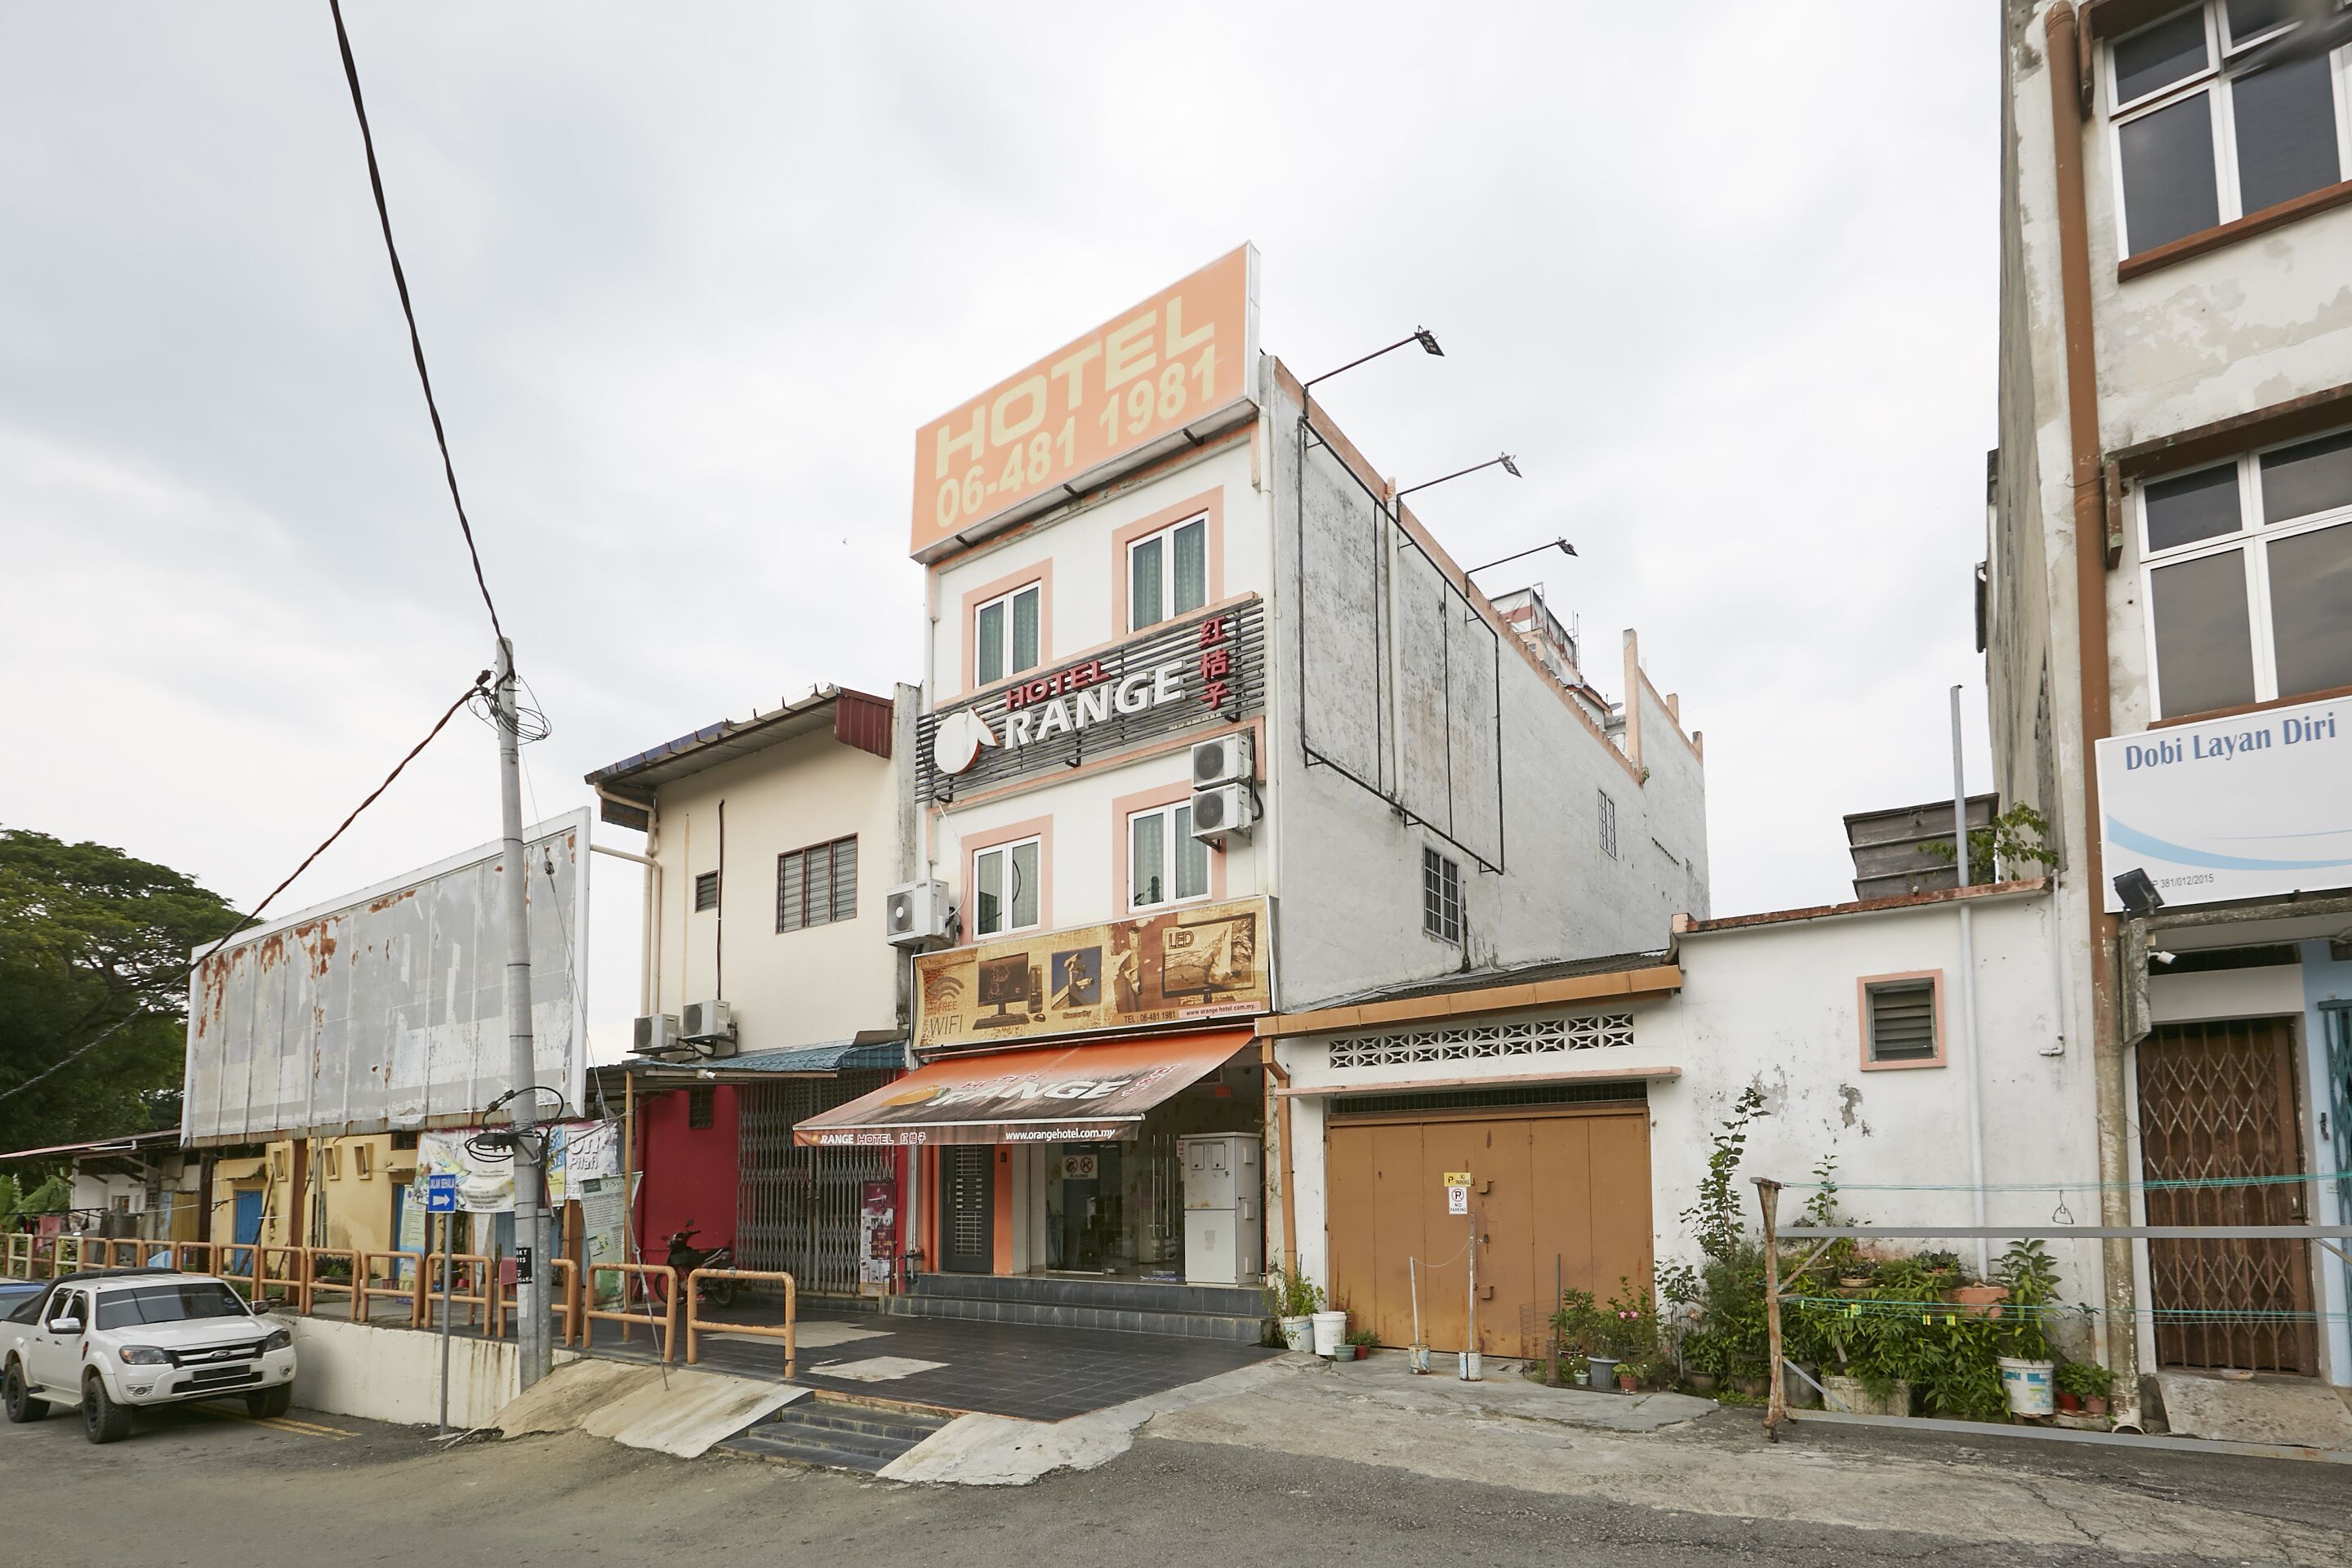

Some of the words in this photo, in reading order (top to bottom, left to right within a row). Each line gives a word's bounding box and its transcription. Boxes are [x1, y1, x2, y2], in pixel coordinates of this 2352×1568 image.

[935, 295, 1215, 480] HOTEL
[935, 416, 1076, 528] 06-481
[1098, 343, 1216, 447] 1981
[1005, 660, 1112, 711] HOTEL
[2125, 737, 2183, 771] Dobi
[2193, 728, 2272, 761] Layan
[2283, 711, 2336, 745] Diri
[2160, 873, 2214, 889] 381/012/2015
[1168, 930, 1195, 950] LED
[938, 1000, 958, 1012] FREE
[929, 1014, 963, 1036] WIFI
[1124, 1015, 1135, 1023] TEL
[1139, 1012, 1160, 1022] 06-481
[1161, 1010, 1176, 1020] 1981
[820, 1134, 854, 1144] RANGE
[857, 1133, 894, 1145] HOTEL
[1005, 1127, 1116, 1142] www.orangehotel.com.my
